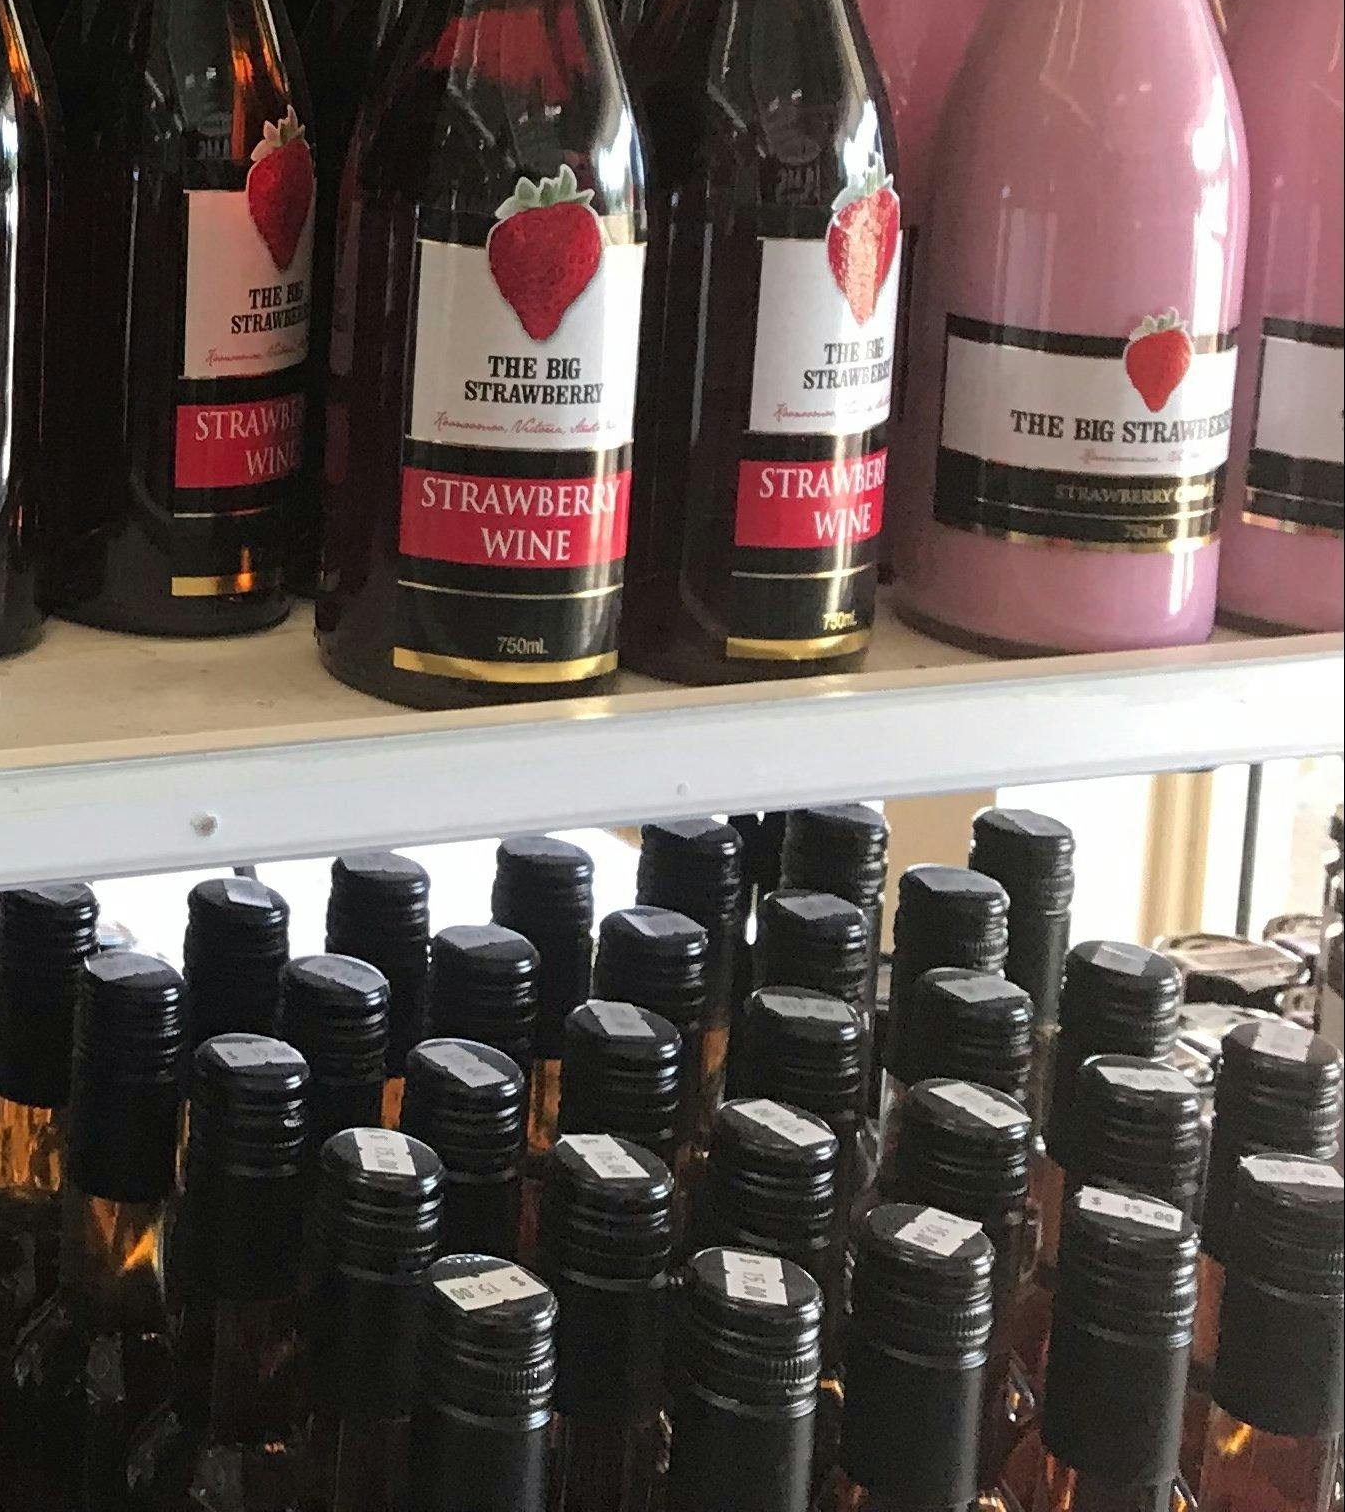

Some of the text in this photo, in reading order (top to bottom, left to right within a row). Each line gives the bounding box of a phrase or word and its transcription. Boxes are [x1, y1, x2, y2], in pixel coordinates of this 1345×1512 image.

[248, 284, 283, 311] THE
[487, 354, 582, 381] THE BIG
[823, 342, 860, 366] THE
[464, 380, 605, 406] STRAWBERRY
[1011, 408, 1065, 439] THE
[1073, 416, 1116, 444] BIG
[420, 476, 621, 518] STRAWBERRY
[813, 502, 873, 540] WINE
[481, 527, 572, 563] WINE
[496, 636, 549, 656] 750mL
